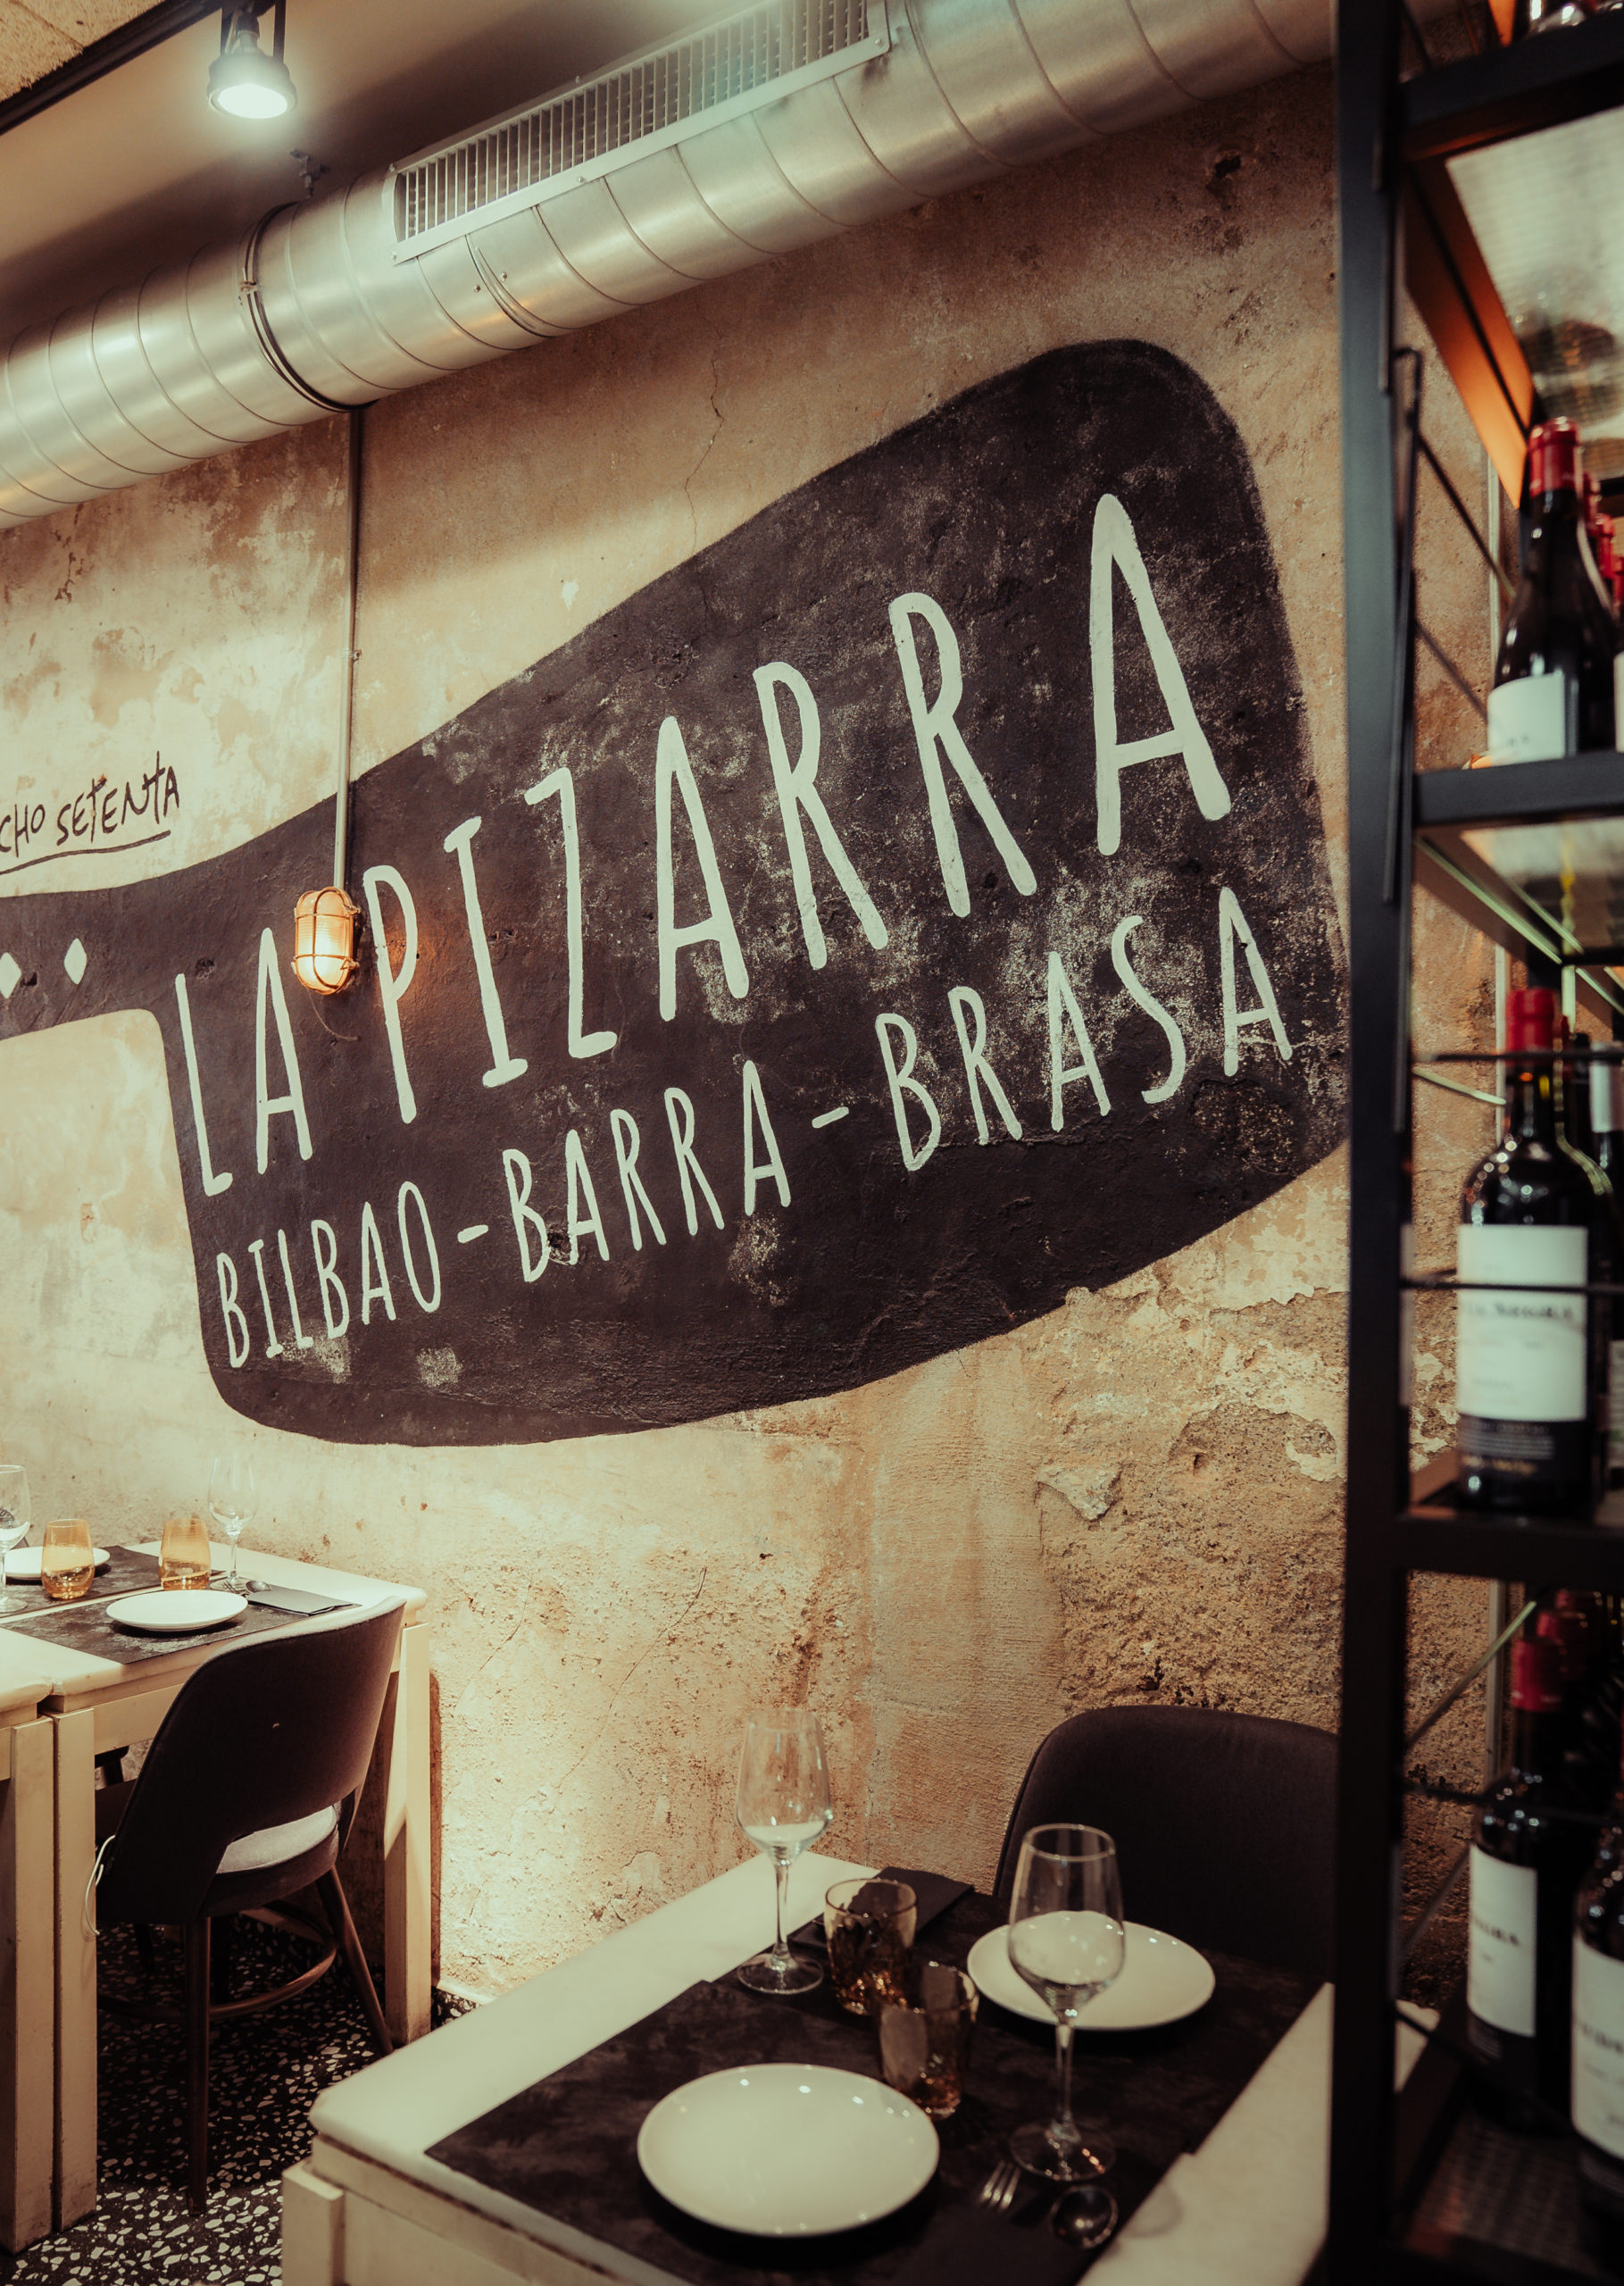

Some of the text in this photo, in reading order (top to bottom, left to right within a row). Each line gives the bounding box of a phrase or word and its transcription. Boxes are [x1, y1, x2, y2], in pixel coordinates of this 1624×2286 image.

[56, 750, 179, 847] SETENTA
[175, 494, 1232, 1197] LA PIZARRA
